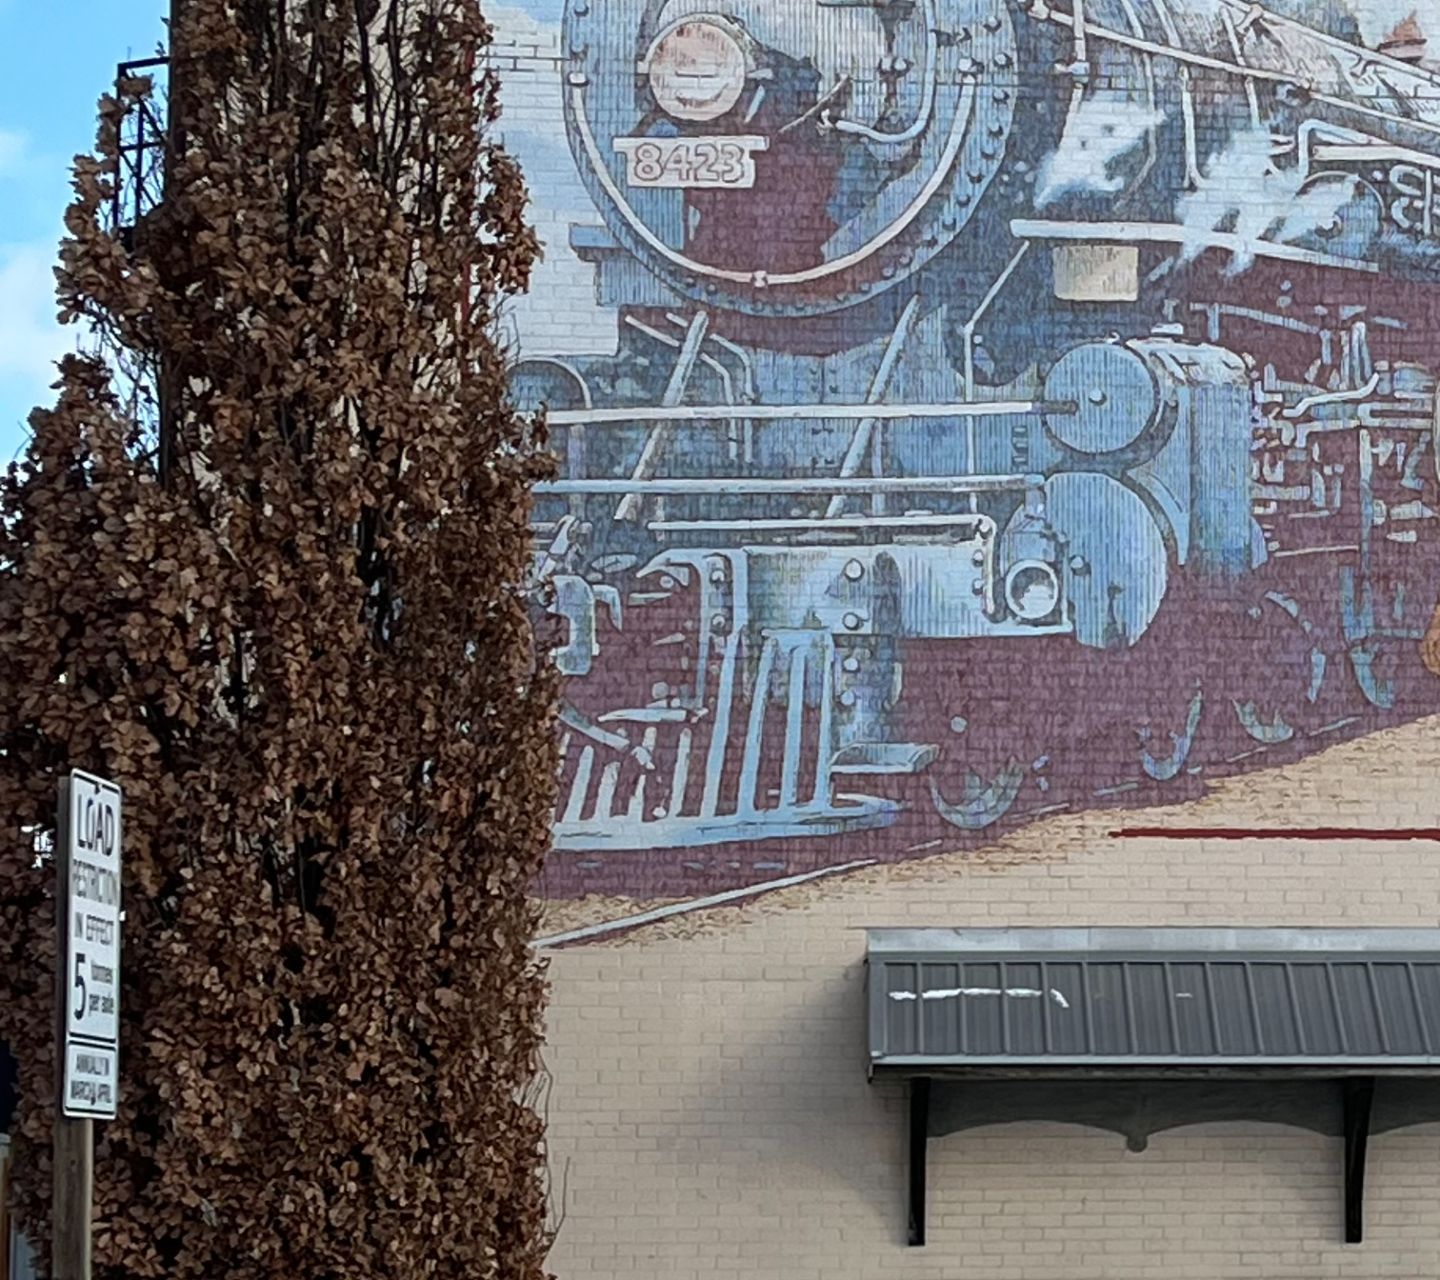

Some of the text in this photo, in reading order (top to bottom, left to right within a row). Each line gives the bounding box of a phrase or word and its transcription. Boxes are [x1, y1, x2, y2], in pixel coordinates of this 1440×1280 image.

[634, 143, 744, 183] 8423
[77, 794, 114, 857] LOAD
[74, 952, 86, 1020] 5
